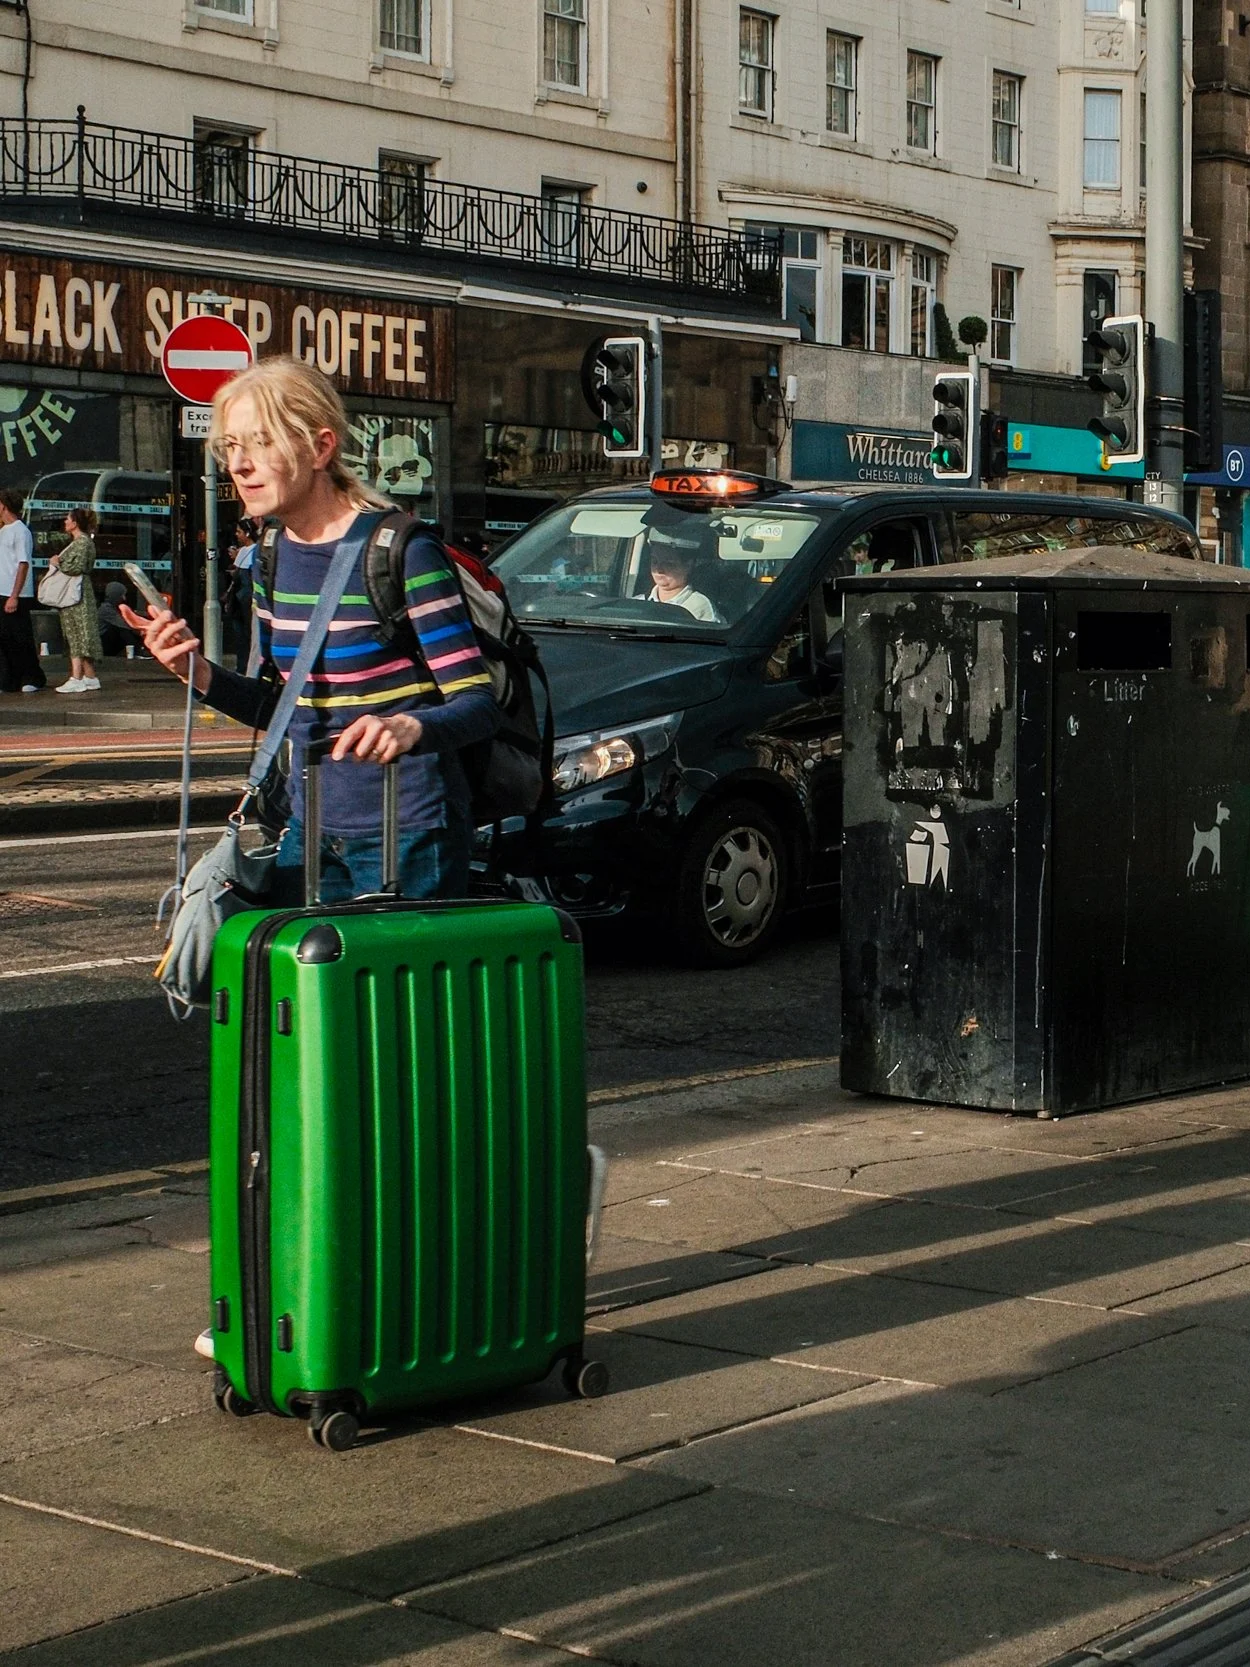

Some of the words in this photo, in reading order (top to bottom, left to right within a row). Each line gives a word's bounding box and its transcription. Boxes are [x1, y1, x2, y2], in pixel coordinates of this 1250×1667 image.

[0, 270, 122, 354] LACK
[292, 304, 427, 384] COFFEE
[0, 391, 76, 462] FFEE
[1229, 459, 1241, 472] BT
[858, 468, 901, 482] CHELSEA
[904, 472, 924, 484] 1886
[1145, 471, 1161, 480] CTY
[665, 478, 714, 491] TAX
[1149, 482, 1158, 491] 13
[1149, 493, 1158, 503] 12
[1103, 677, 1147, 702] Litter
